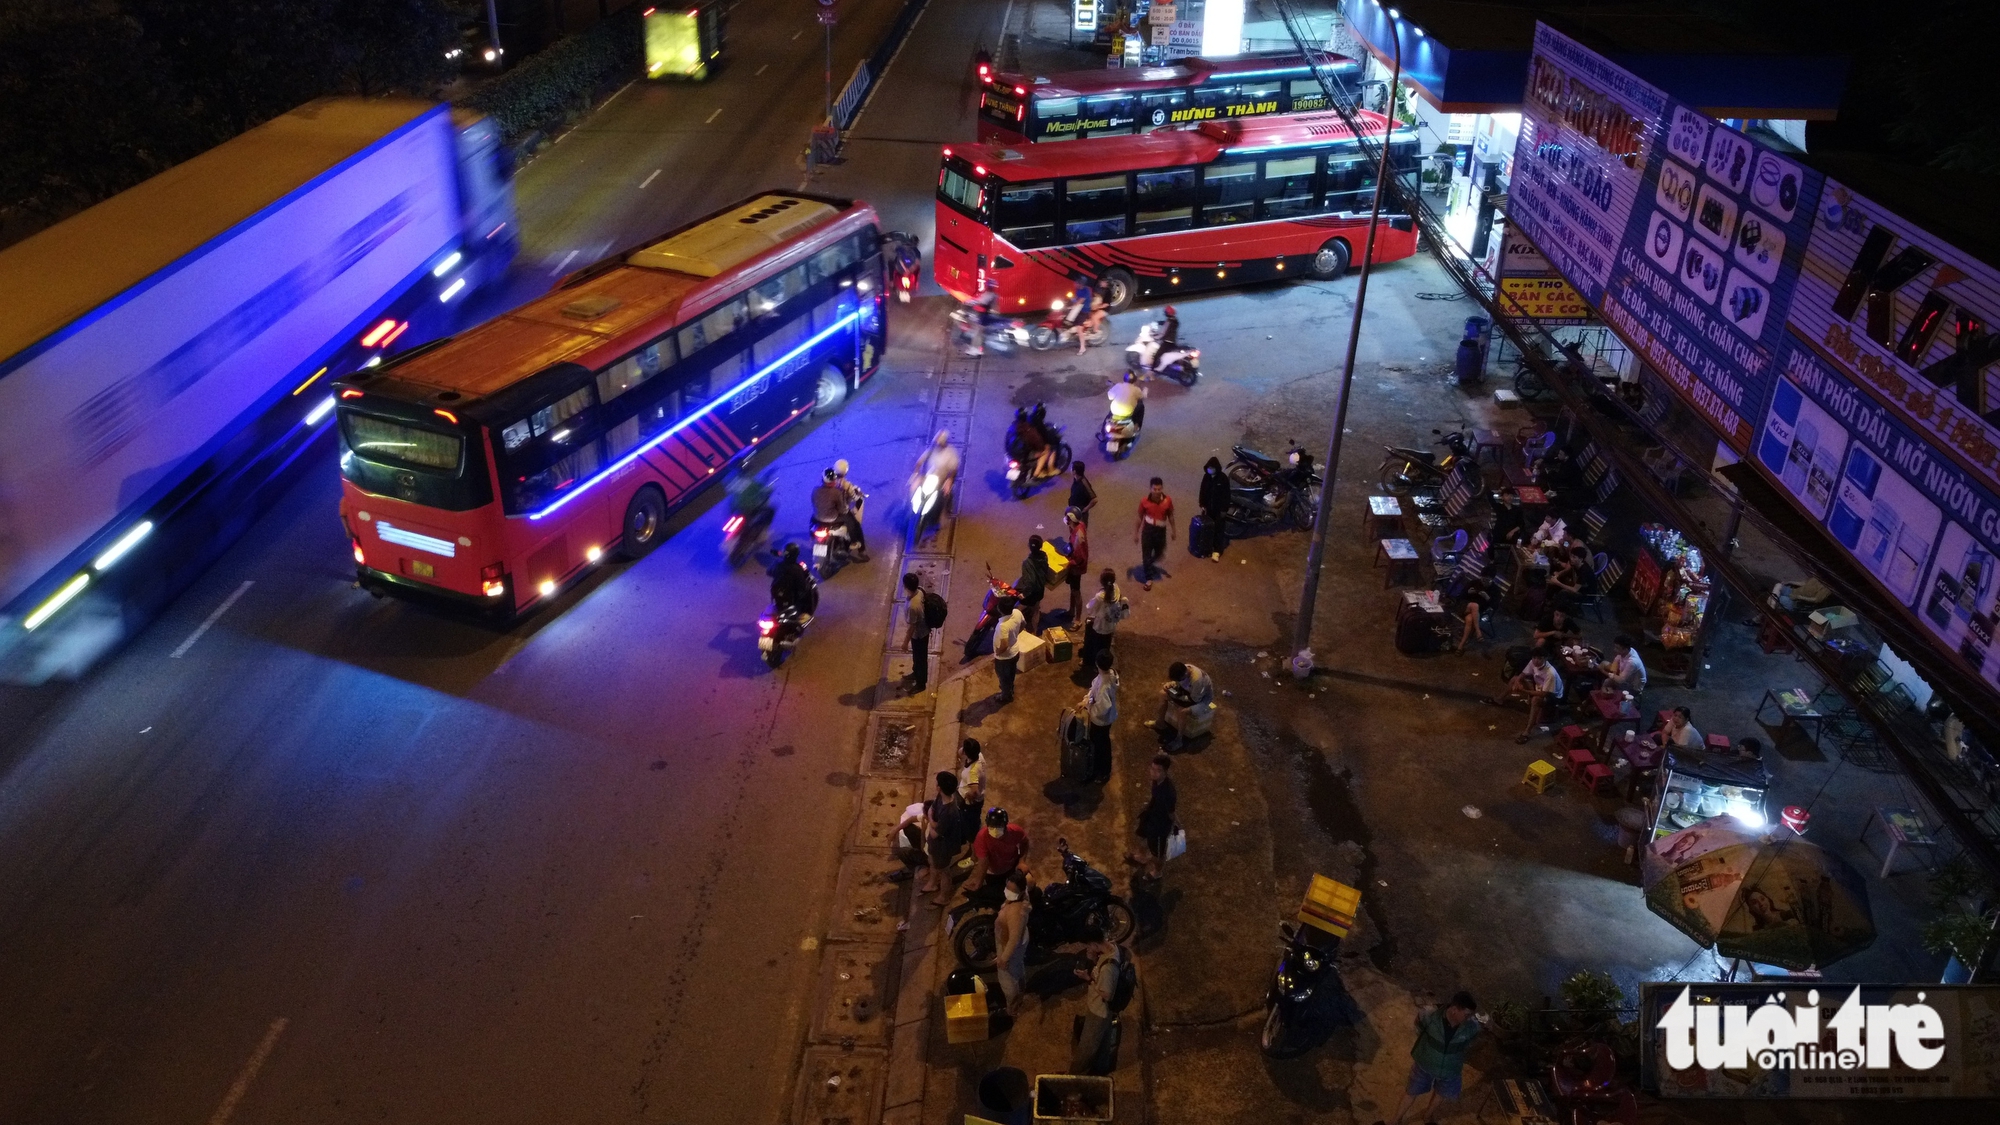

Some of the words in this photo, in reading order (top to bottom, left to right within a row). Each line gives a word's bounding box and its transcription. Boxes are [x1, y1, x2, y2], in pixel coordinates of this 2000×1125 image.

[1171, 105, 1216, 122] HƯNG
[1226, 100, 1278, 116] THÀNH
[1581, 166, 1614, 214] ĐÀO
[1508, 244, 1538, 254] Kix
[1508, 290, 1540, 301] BÁN
[1546, 290, 1575, 301] CÁC
[1534, 304, 1554, 314] XE
[1620, 247, 1636, 270] CÁC
[1633, 259, 1653, 287] LOẠI
[1651, 273, 1673, 306] BƠM,
[1673, 291, 1706, 335] NHÔNG,
[1706, 319, 1734, 355] CHÂN
[1733, 341, 1761, 378] CHẠY
[1620, 284, 1631, 304] XE
[1630, 293, 1647, 318] ĐÀO
[1649, 310, 1662, 333] XE
[1674, 332, 1687, 356] XE
[1684, 342, 1699, 367] LU
[1701, 357, 1716, 383] XE
[1714, 368, 1743, 407] NÂNG
[1832, 224, 2000, 430] Kix
[1692, 378, 1739, 436] 0937.874.488
[1787, 349, 1823, 395] PHÂN
[1823, 377, 1857, 424] PHỐI
[1857, 405, 1889, 456] DẦU,
[1894, 434, 1925, 483] MỠ
[1926, 461, 1976, 527] NHỜN
